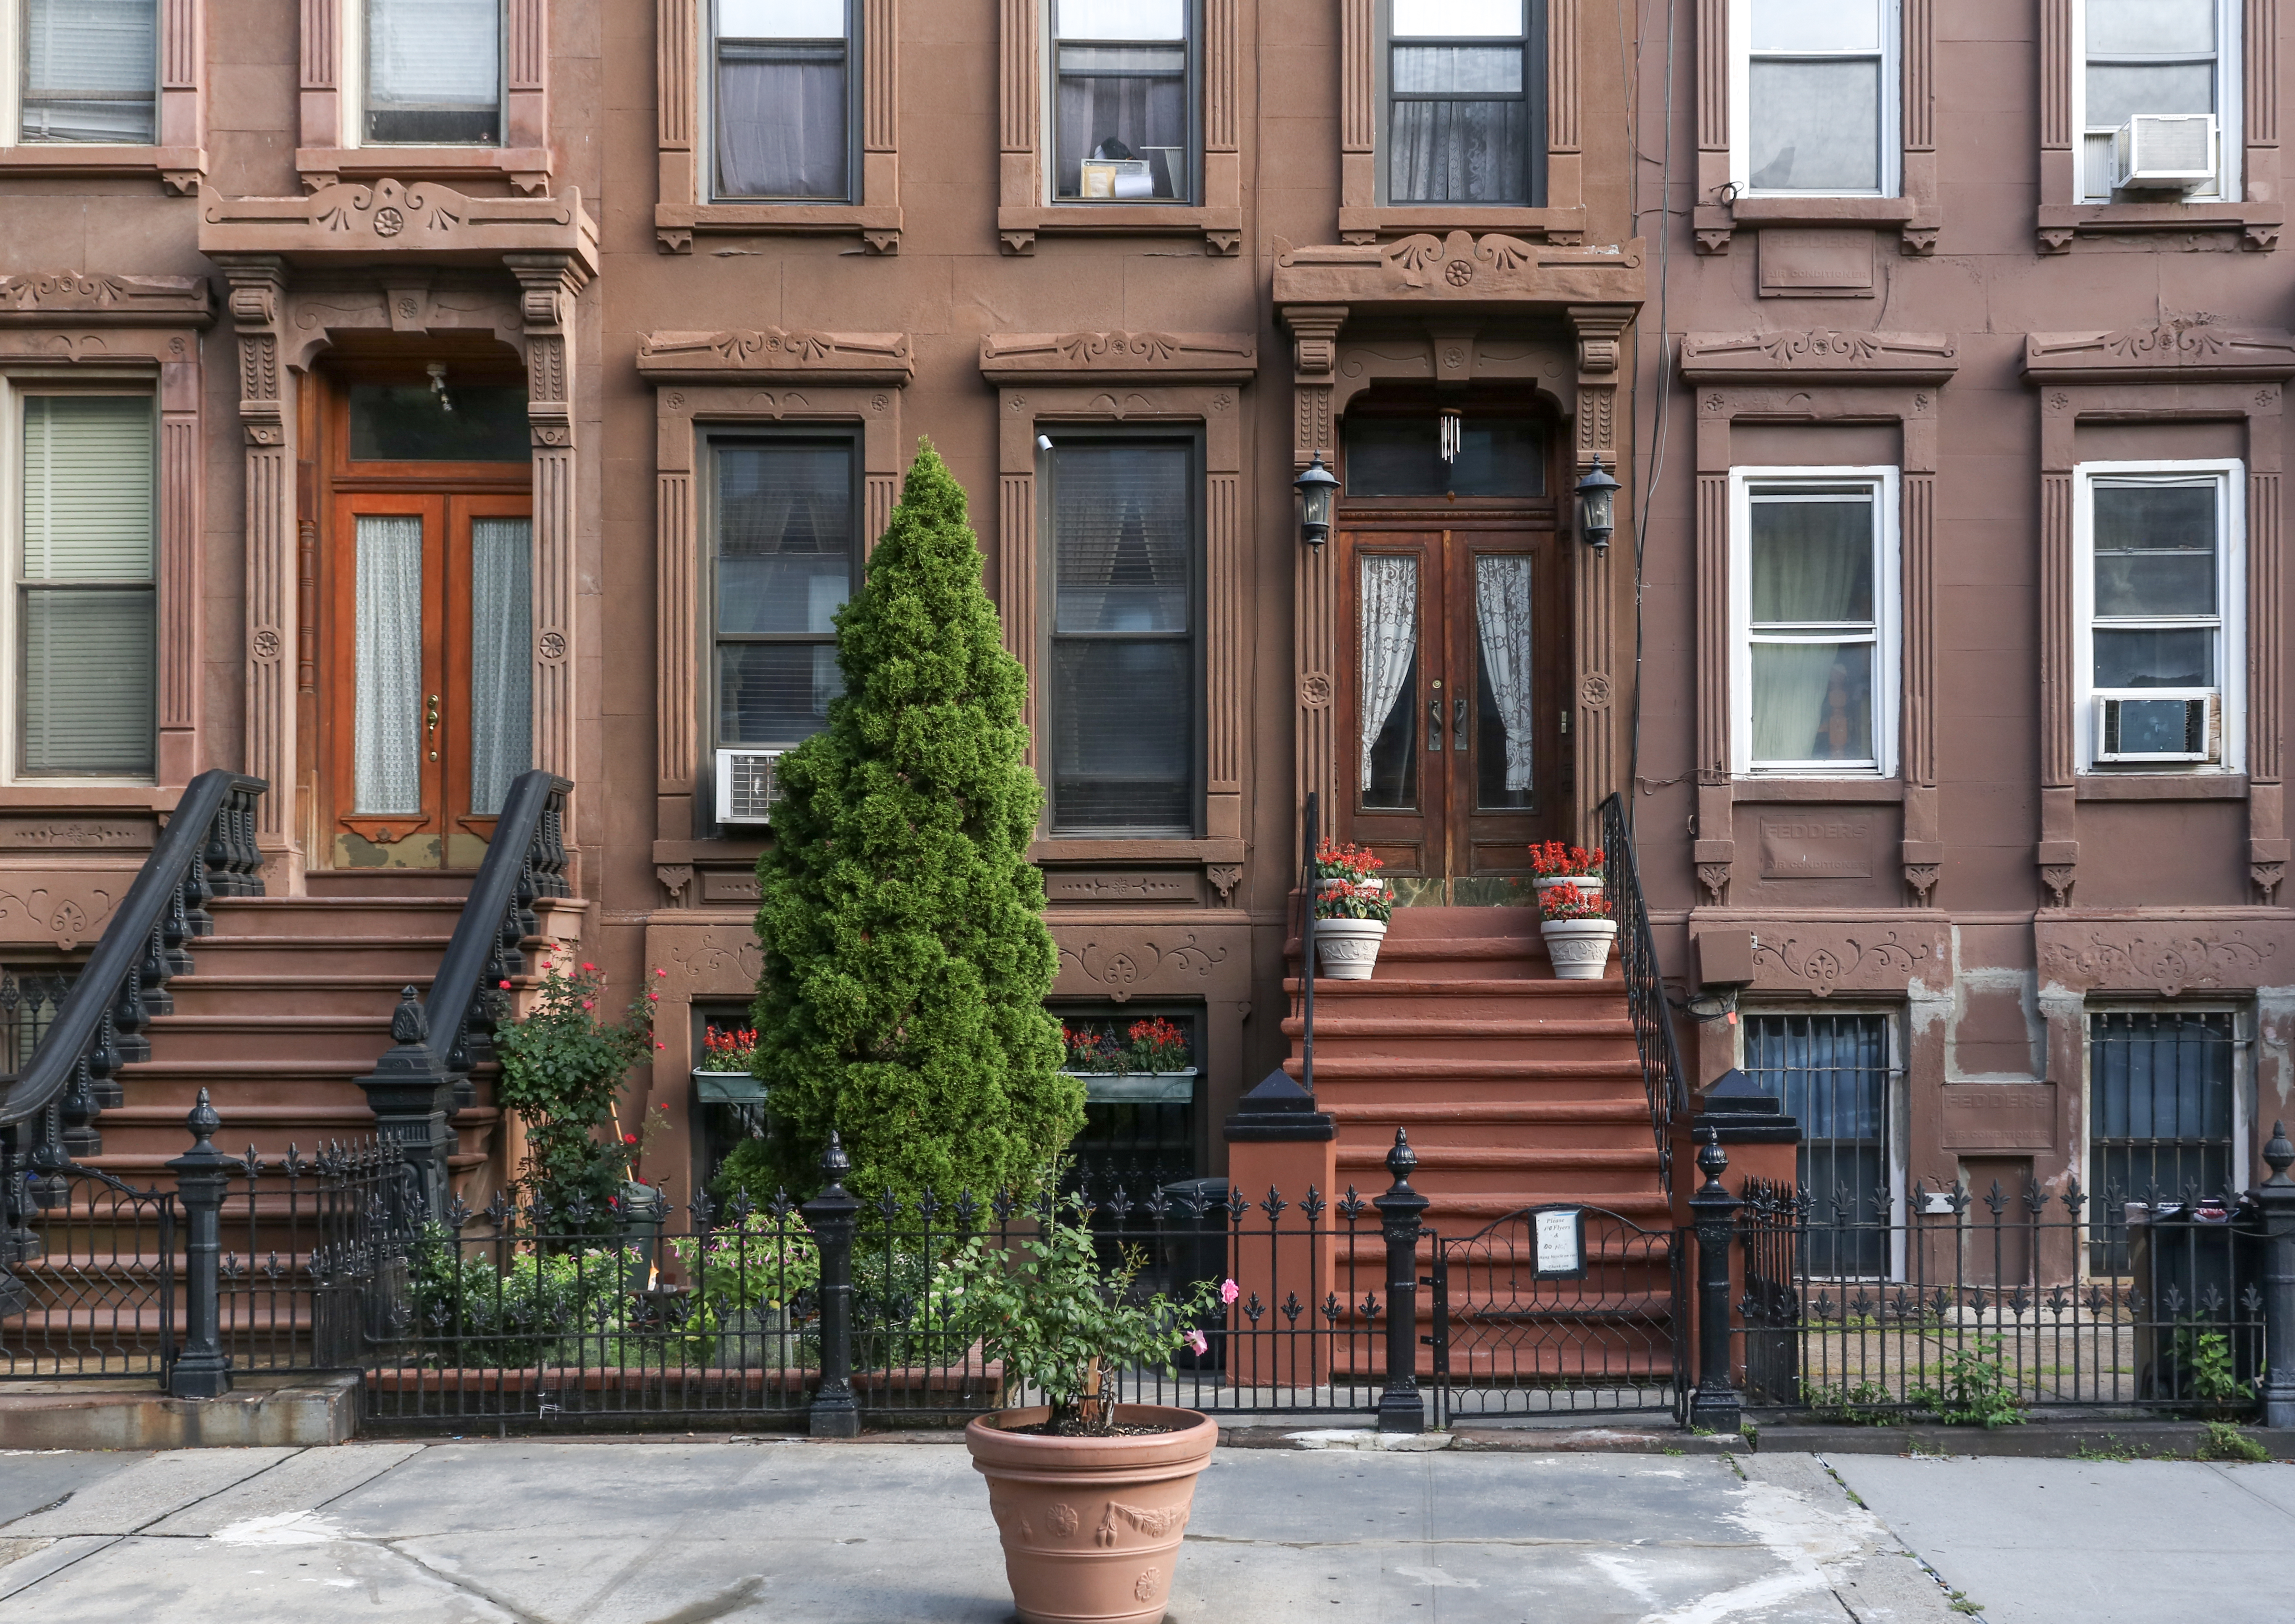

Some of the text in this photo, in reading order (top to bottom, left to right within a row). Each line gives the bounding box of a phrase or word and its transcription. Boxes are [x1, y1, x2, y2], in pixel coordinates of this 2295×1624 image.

[1765, 234, 1868, 248] FEDDERS
[1765, 269, 1868, 279] AIR CONDITIONER
[1764, 824, 1868, 839] FEDDERS
[1765, 860, 1867, 869] AIR CONDITIONER
[1944, 1093, 2050, 1109] FEDDERS
[1945, 1130, 2049, 1139] AIR CONDITIONER
